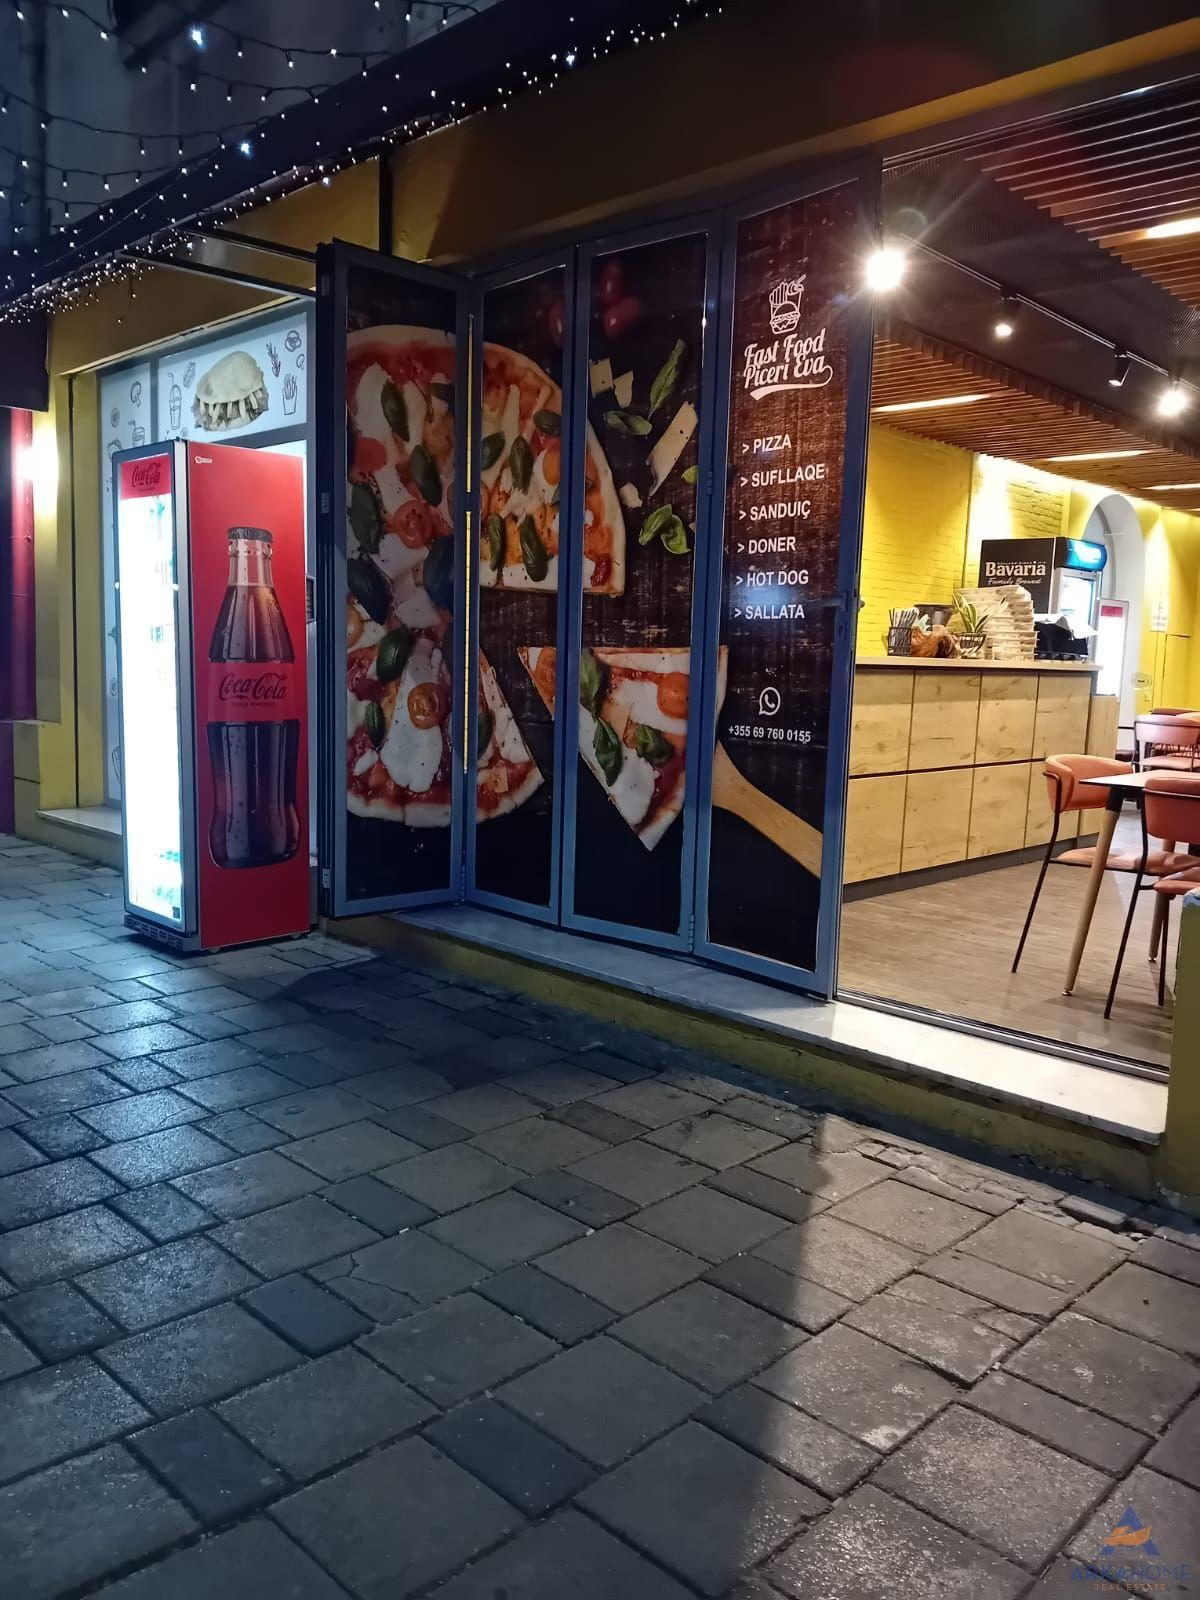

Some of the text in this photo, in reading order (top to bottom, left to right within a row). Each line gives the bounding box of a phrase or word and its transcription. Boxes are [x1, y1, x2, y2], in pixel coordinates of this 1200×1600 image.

[744, 328, 826, 367] Fast Food
[744, 353, 826, 388] Piceri Eva
[753, 434, 791, 454] PIZZA
[752, 463, 825, 487] SUFLLAQE
[750, 500, 811, 521] SANDUIÇ
[748, 536, 796, 554] DONER
[747, 569, 809, 587] HOT DOG
[985, 561, 1046, 577] Bavaria
[745, 604, 805, 620] SALLATA
[219, 672, 288, 701] Coca-Cola
[728, 725, 811, 743] +355 69 760 0155
